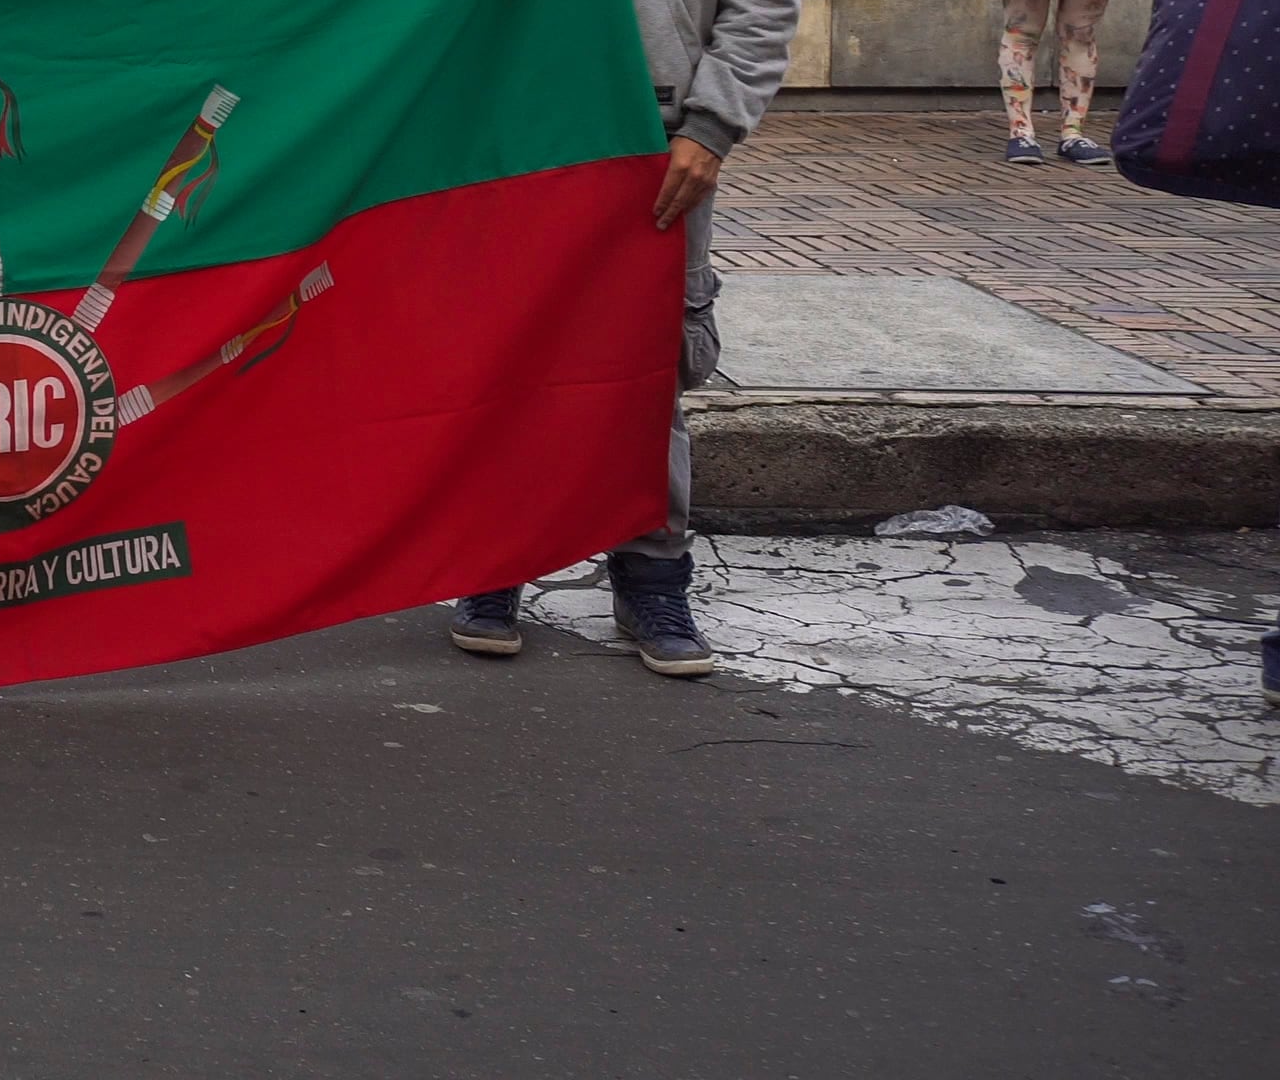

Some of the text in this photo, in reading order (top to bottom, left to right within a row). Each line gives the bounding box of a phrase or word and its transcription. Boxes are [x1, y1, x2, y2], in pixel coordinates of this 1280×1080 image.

[89, 396, 115, 444] DEL
[24, 452, 102, 521] CAUCA
[41, 555, 60, 590] Y
[66, 532, 182, 586] CULTURA
